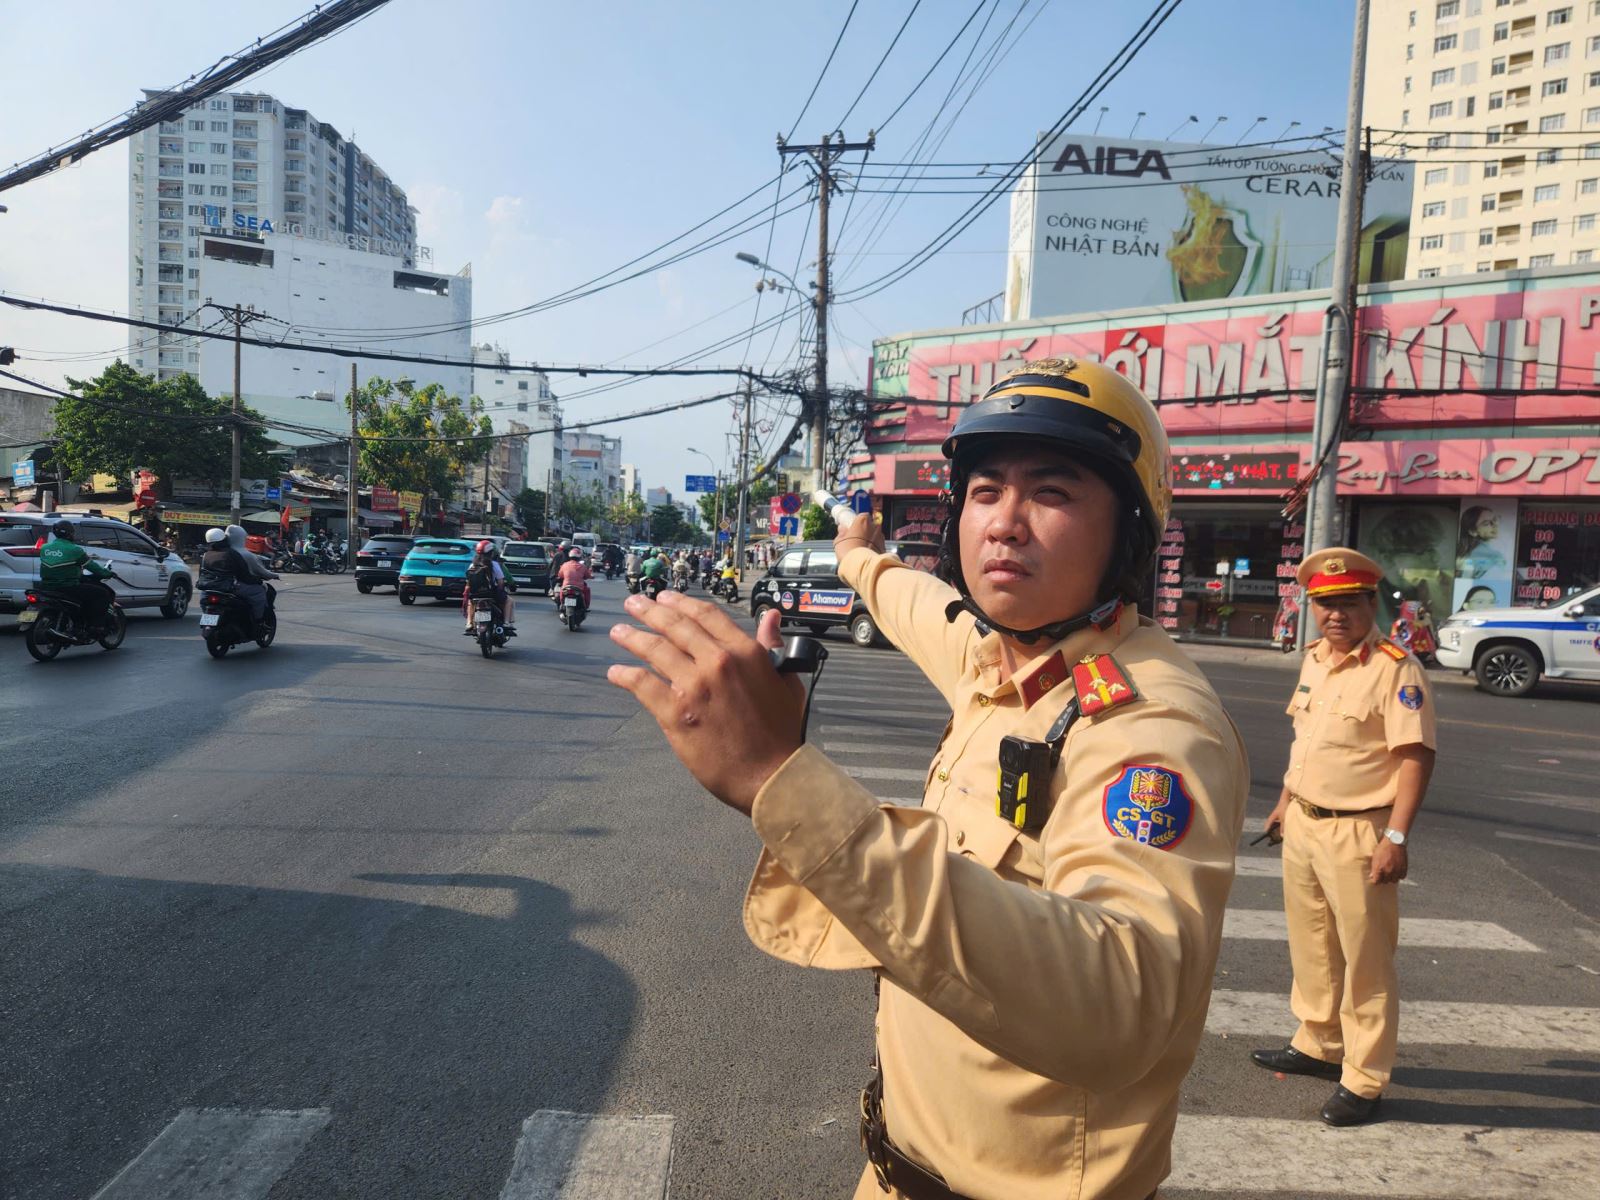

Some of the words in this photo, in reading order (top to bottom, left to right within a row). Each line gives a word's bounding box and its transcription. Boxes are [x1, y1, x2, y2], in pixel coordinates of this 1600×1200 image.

[1052, 144, 1172, 180] AICA
[1207, 154, 1232, 169] TẤM
[1254, 159, 1297, 173] TƯỜNG
[1046, 212, 1097, 231] CÔNG
[1101, 217, 1149, 235] NGHỆ
[233, 212, 273, 233] SEA
[374, 239, 432, 260] TOWER
[1045, 233, 1107, 257] NHẬT
[1112, 234, 1160, 258] BẢN
[1184, 312, 1320, 407] MẮT
[1366, 307, 1563, 393] KÍNH
[1535, 530, 1554, 542] ĐO
[44, 549, 63, 558] Grab
[811, 593, 848, 606] Ahamove
[1543, 586, 1561, 600] ĐO
[1117, 807, 1142, 822] CS
[1150, 810, 1176, 829] GT
